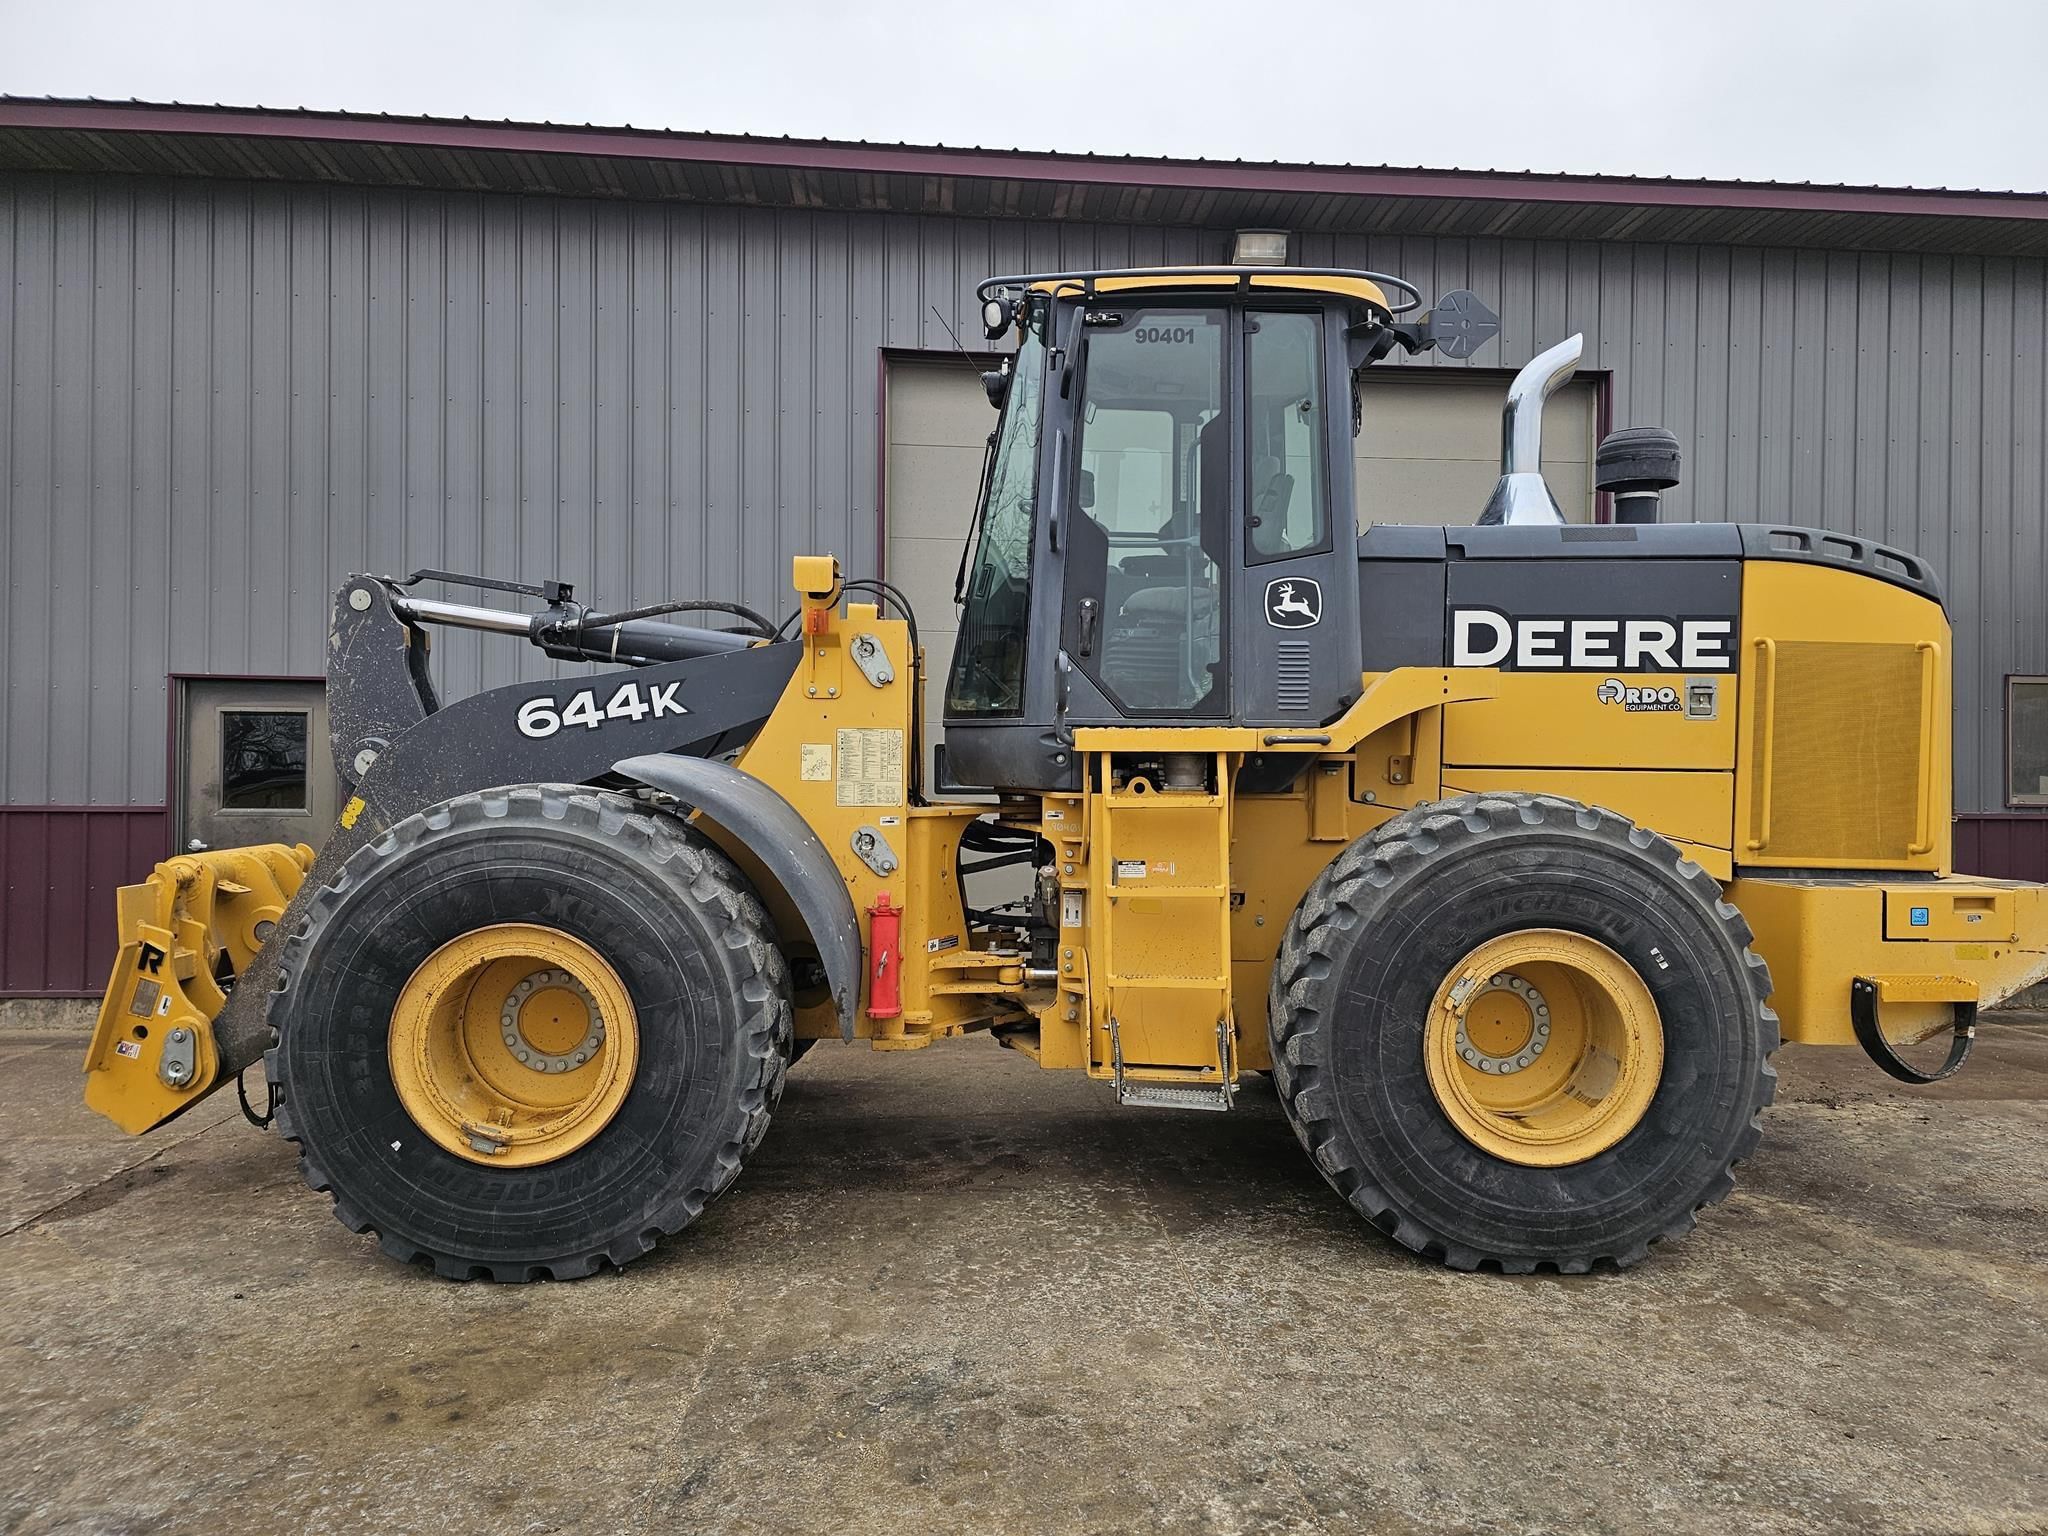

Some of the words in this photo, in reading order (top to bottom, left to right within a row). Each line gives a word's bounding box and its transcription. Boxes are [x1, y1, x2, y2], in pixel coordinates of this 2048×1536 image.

[1135, 327, 1194, 344] 90401
[1453, 610, 1731, 667] DEERE
[517, 682, 688, 738] 644K
[1625, 704, 1667, 712] EQUIPMENT
[138, 941, 165, 975] R
